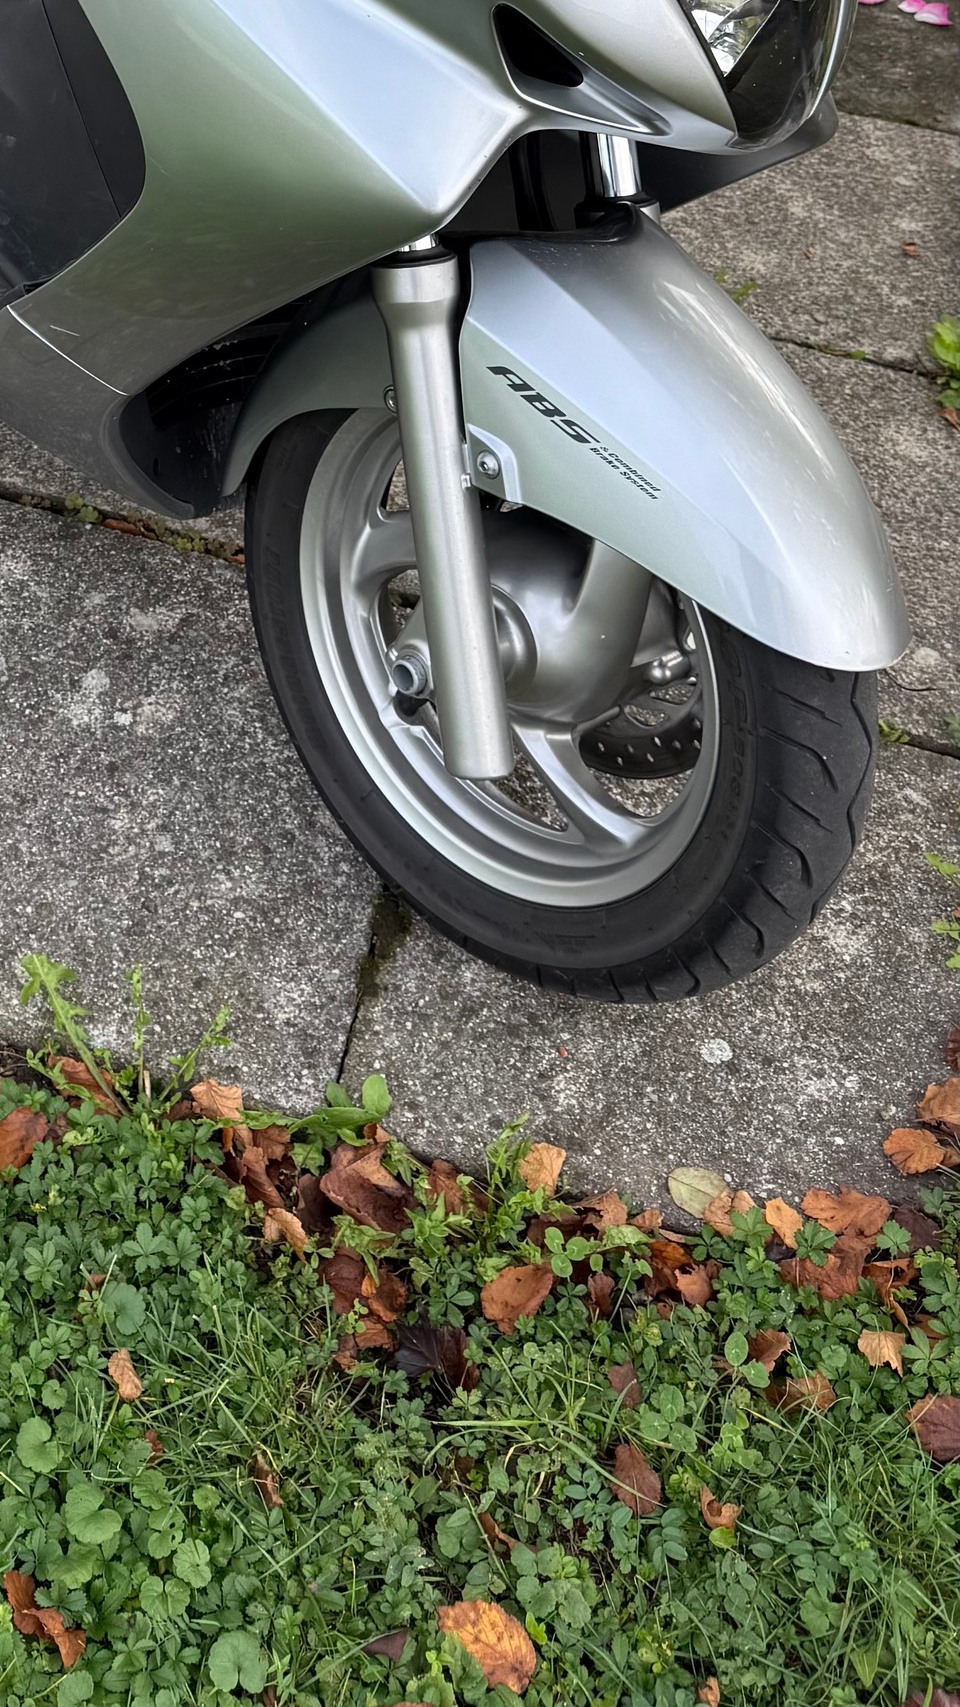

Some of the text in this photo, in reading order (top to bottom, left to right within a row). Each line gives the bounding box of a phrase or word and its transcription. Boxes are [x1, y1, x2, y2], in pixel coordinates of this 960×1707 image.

[486, 366, 601, 444] ABS
[590, 447, 658, 500] Brake System
[608, 452, 661, 492] Combined
